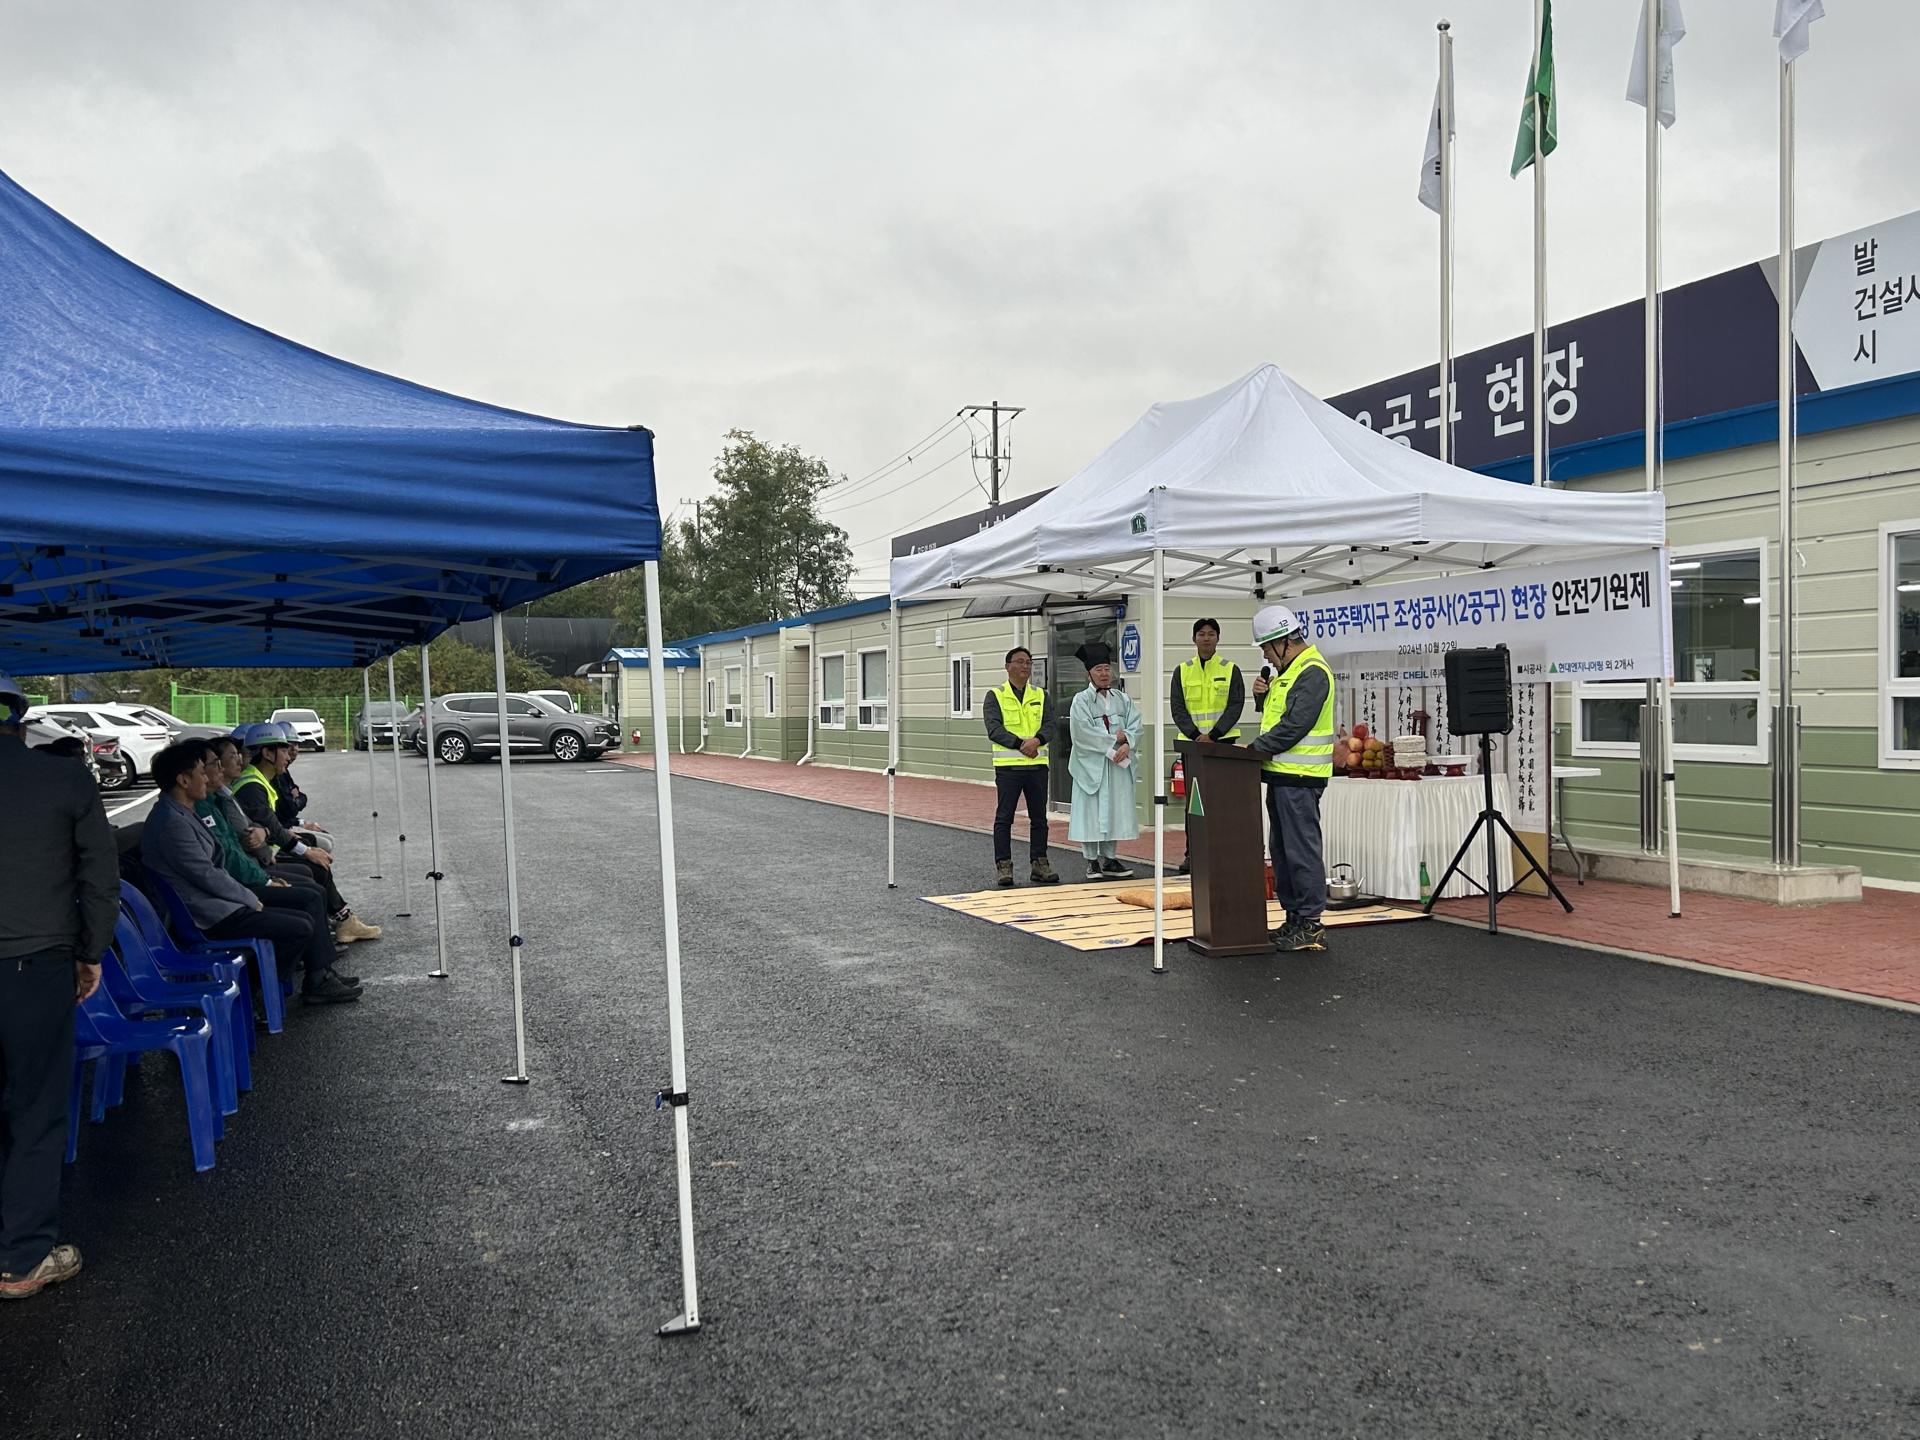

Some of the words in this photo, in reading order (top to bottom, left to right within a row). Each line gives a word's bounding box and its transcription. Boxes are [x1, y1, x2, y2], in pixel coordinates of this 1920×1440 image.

[1854, 238, 1878, 276] 발
[1853, 329, 1876, 364] 시
[1486, 341, 1584, 437] 현장
[1292, 610, 1310, 639] 장
[1313, 601, 1390, 639] 공공주택지구
[1394, 588, 1506, 630] 조성공사(2공구)
[1511, 583, 1548, 620] 현장
[1552, 571, 1651, 616] 안전기원제
[1124, 639, 1138, 656] ADT
[1398, 643, 1422, 655] 2024년
[1424, 642, 1440, 654] 10월
[1403, 669, 1429, 680] CHEIL
[1558, 661, 1604, 673] 현대엔지니어링
[1605, 660, 1613, 671] 외
[1614, 658, 1634, 670] 2개사
